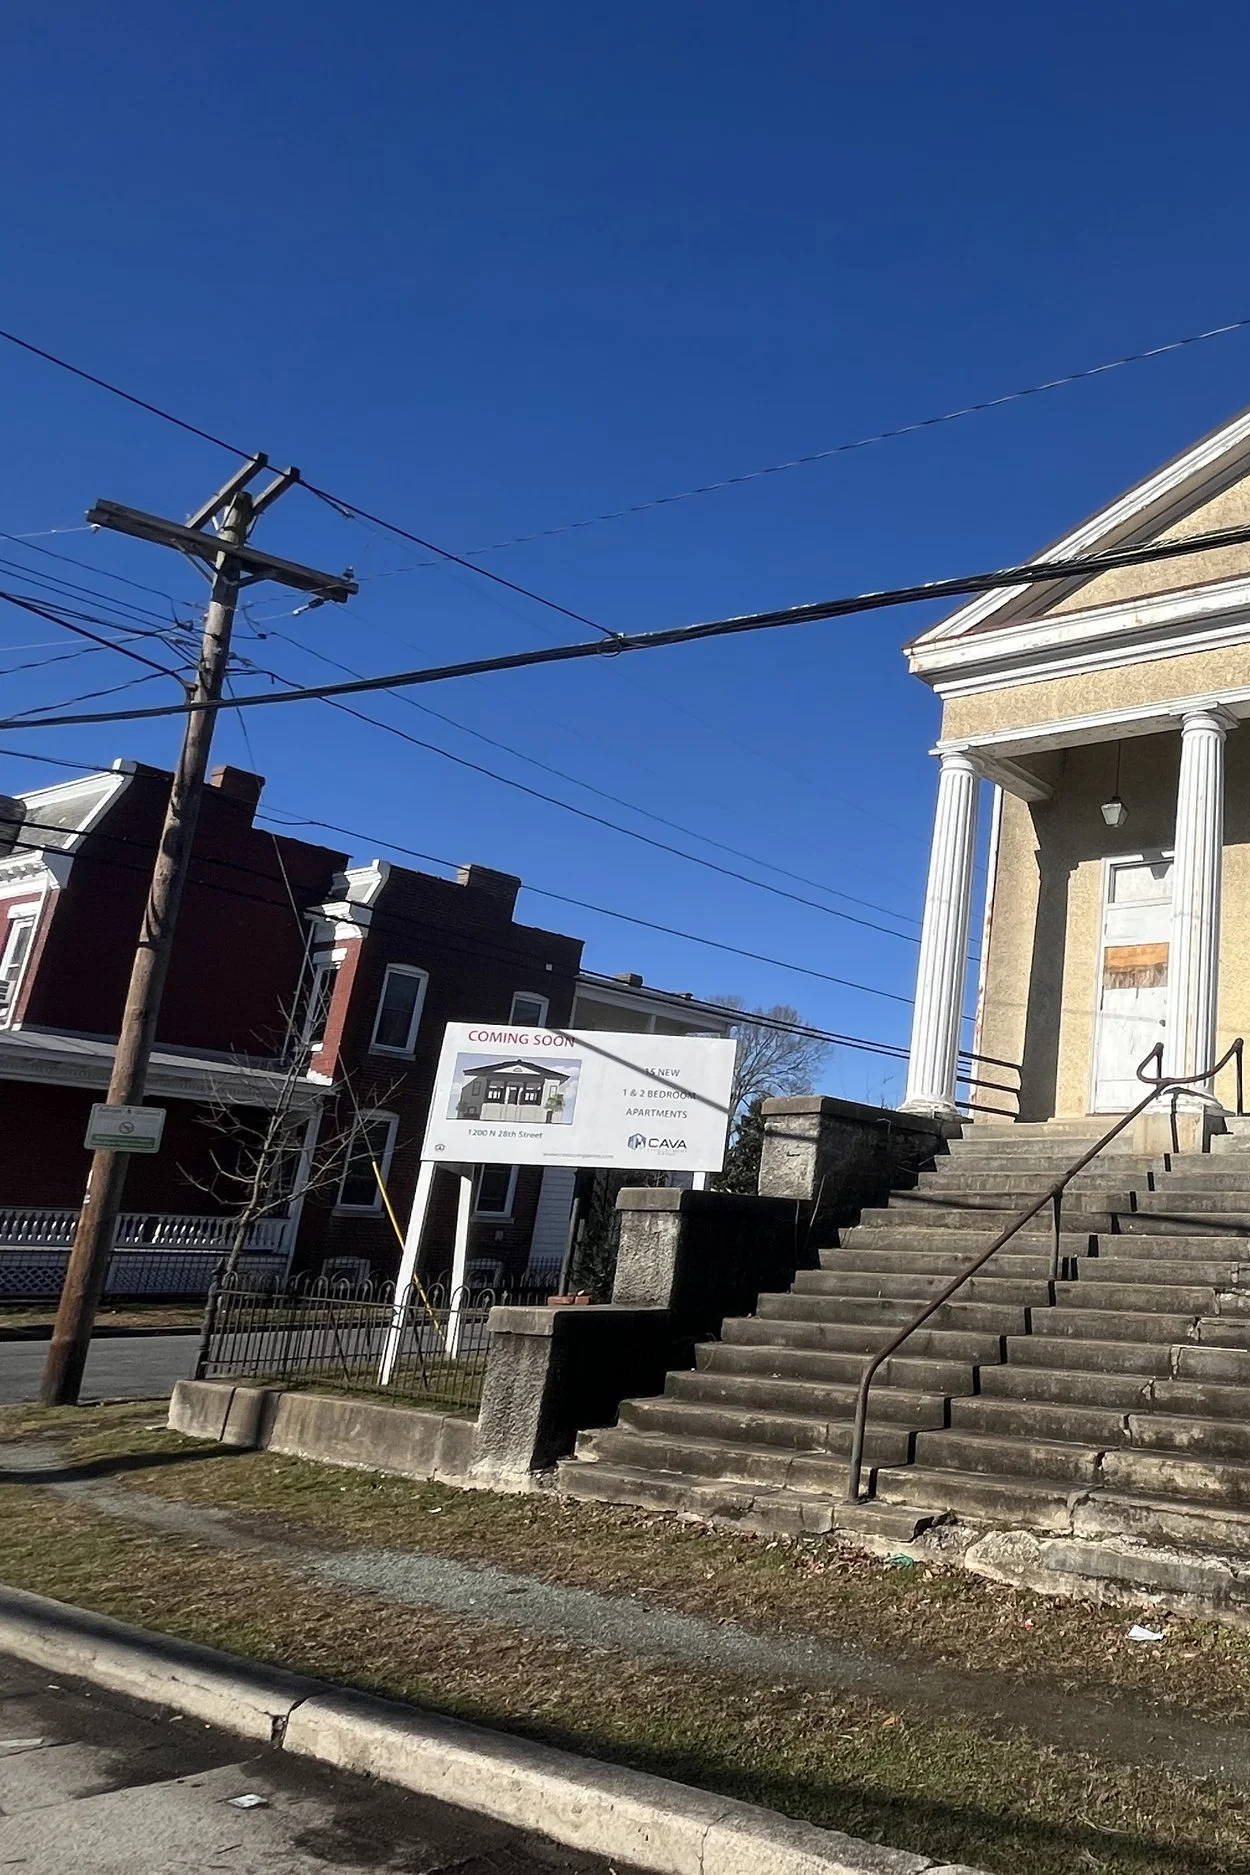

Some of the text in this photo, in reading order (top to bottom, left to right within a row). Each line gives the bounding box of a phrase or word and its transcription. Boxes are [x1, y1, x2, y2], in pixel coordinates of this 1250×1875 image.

[468, 1030, 575, 1047] COMING SOON
[657, 1068, 680, 1077] NEW
[622, 1088, 697, 1101] 1 & 2 BEDROOM
[625, 1107, 688, 1119] APARTMENTS
[468, 1128, 543, 1139] 1200 N 28th Street
[648, 1138, 688, 1149] CAVA
